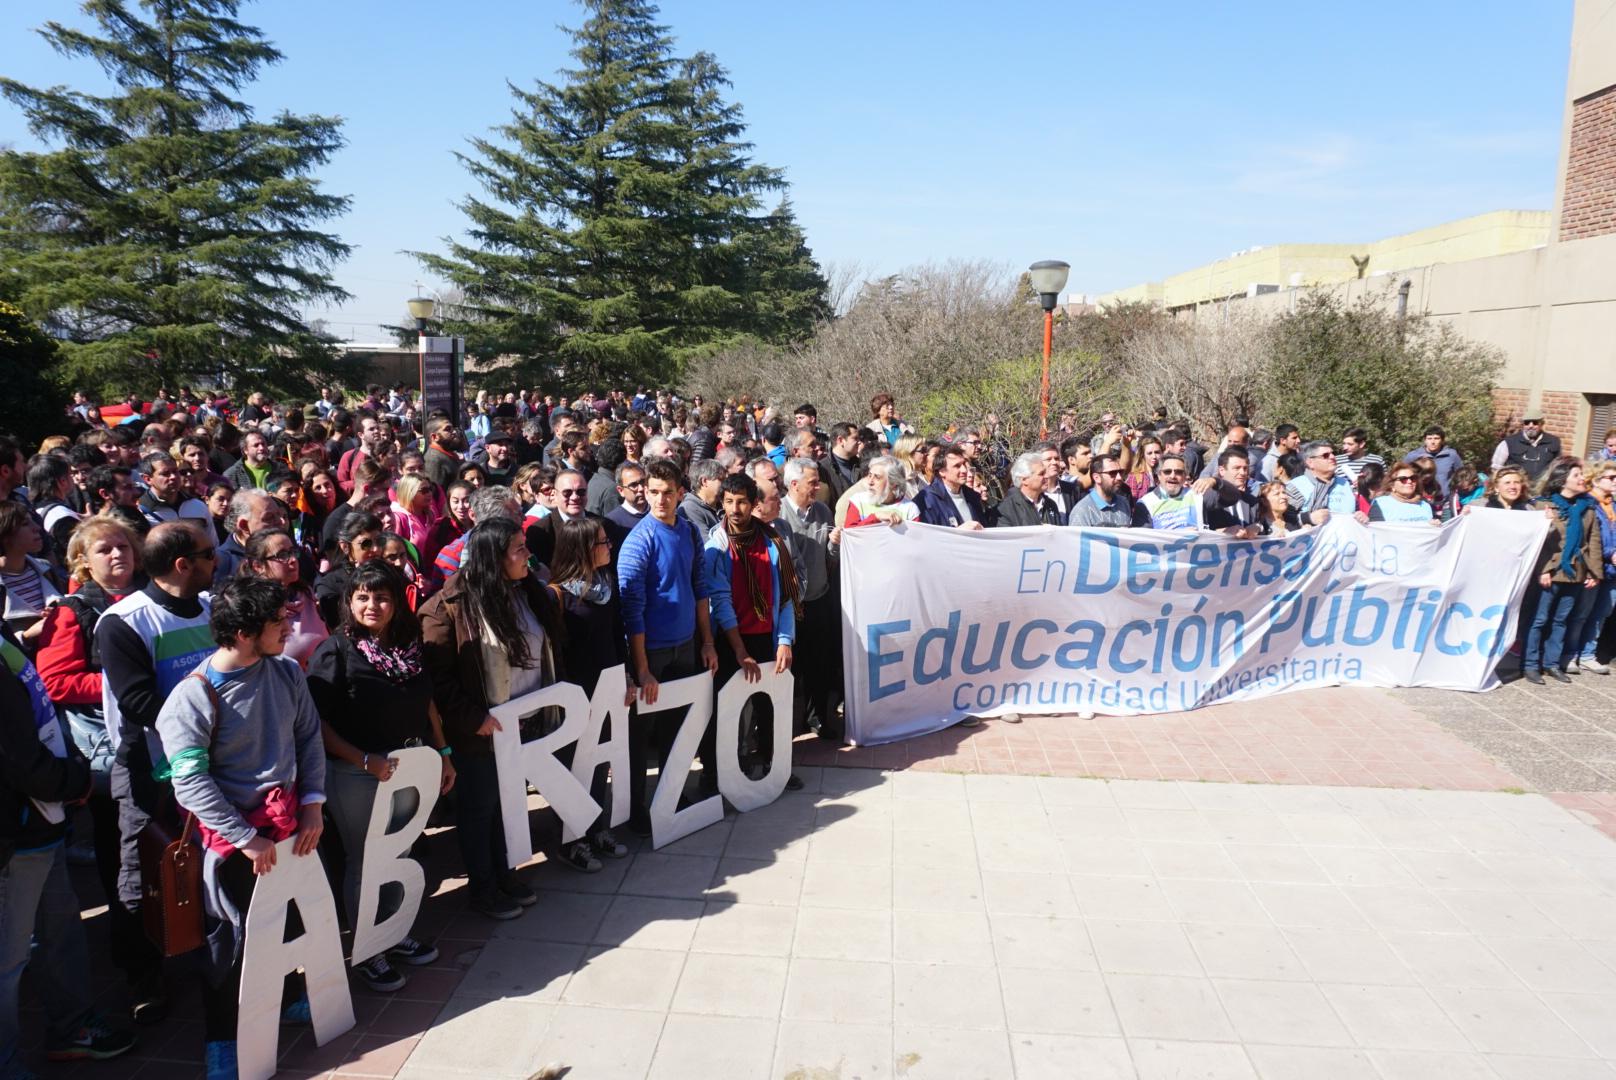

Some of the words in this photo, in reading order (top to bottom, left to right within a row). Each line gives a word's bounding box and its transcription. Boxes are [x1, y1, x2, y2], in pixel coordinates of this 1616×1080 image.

[1017, 548, 1067, 594] En
[1072, 530, 1315, 596] Defensa
[1319, 532, 1358, 573] de
[1371, 532, 1399, 576] la
[867, 595, 1246, 704] Educación
[1259, 579, 1509, 659] Pública
[952, 679, 1168, 712] Comunidad
